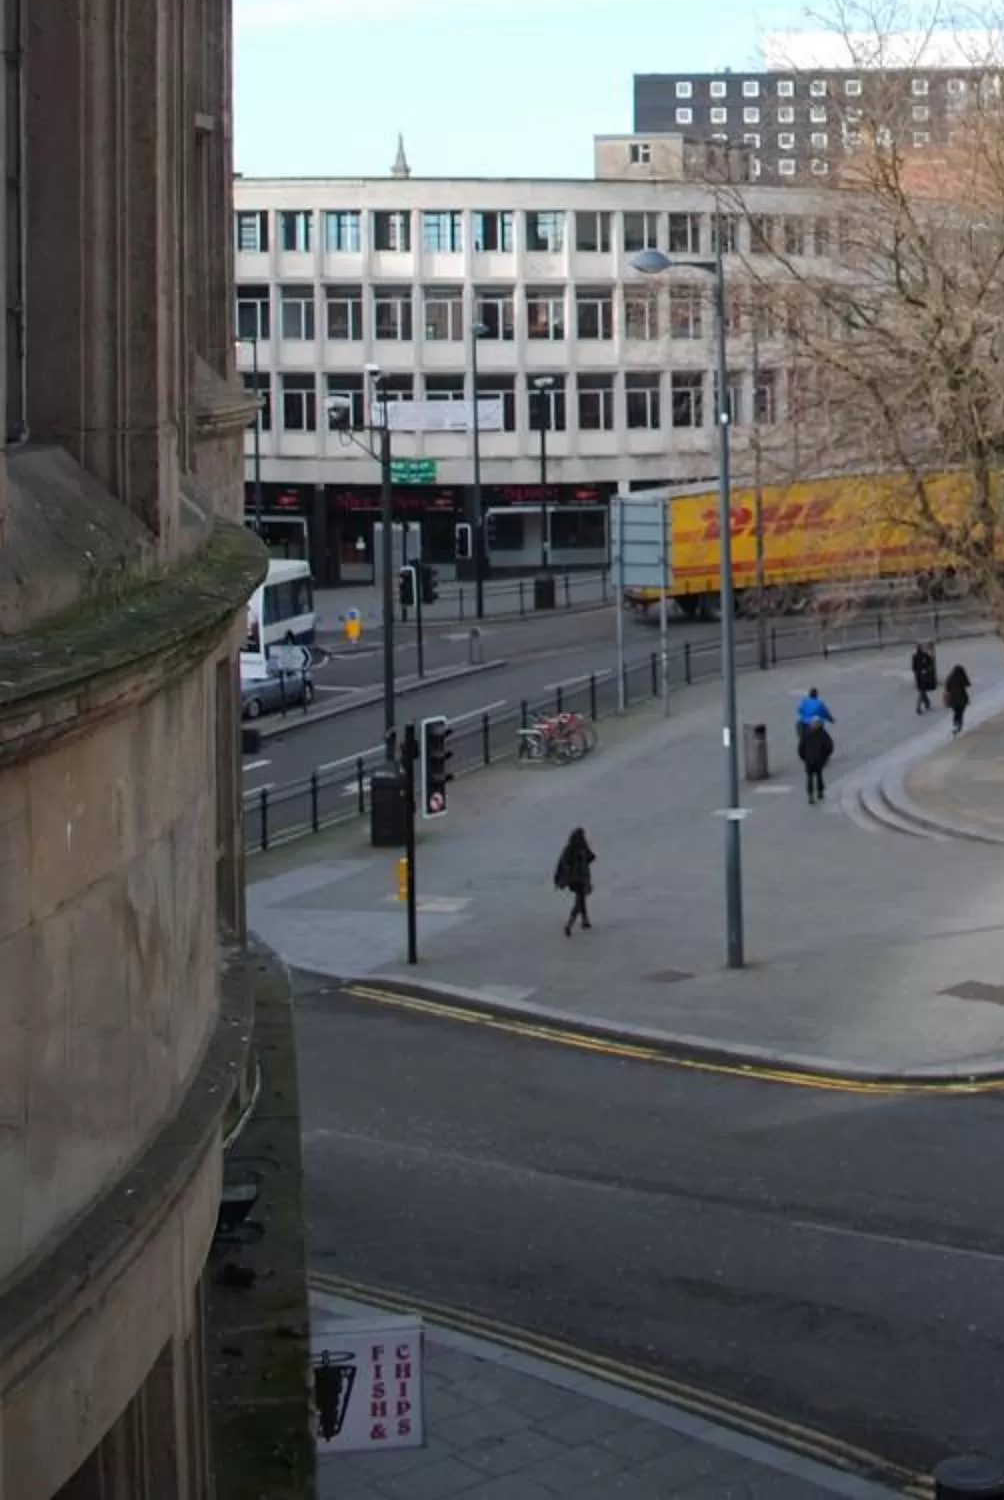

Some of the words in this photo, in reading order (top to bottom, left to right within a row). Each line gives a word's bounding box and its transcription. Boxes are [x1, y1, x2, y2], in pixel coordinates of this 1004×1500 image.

[702, 501, 836, 540] DHL
[370, 1346, 387, 1418] FISH
[395, 1344, 412, 1436] CHIPS
